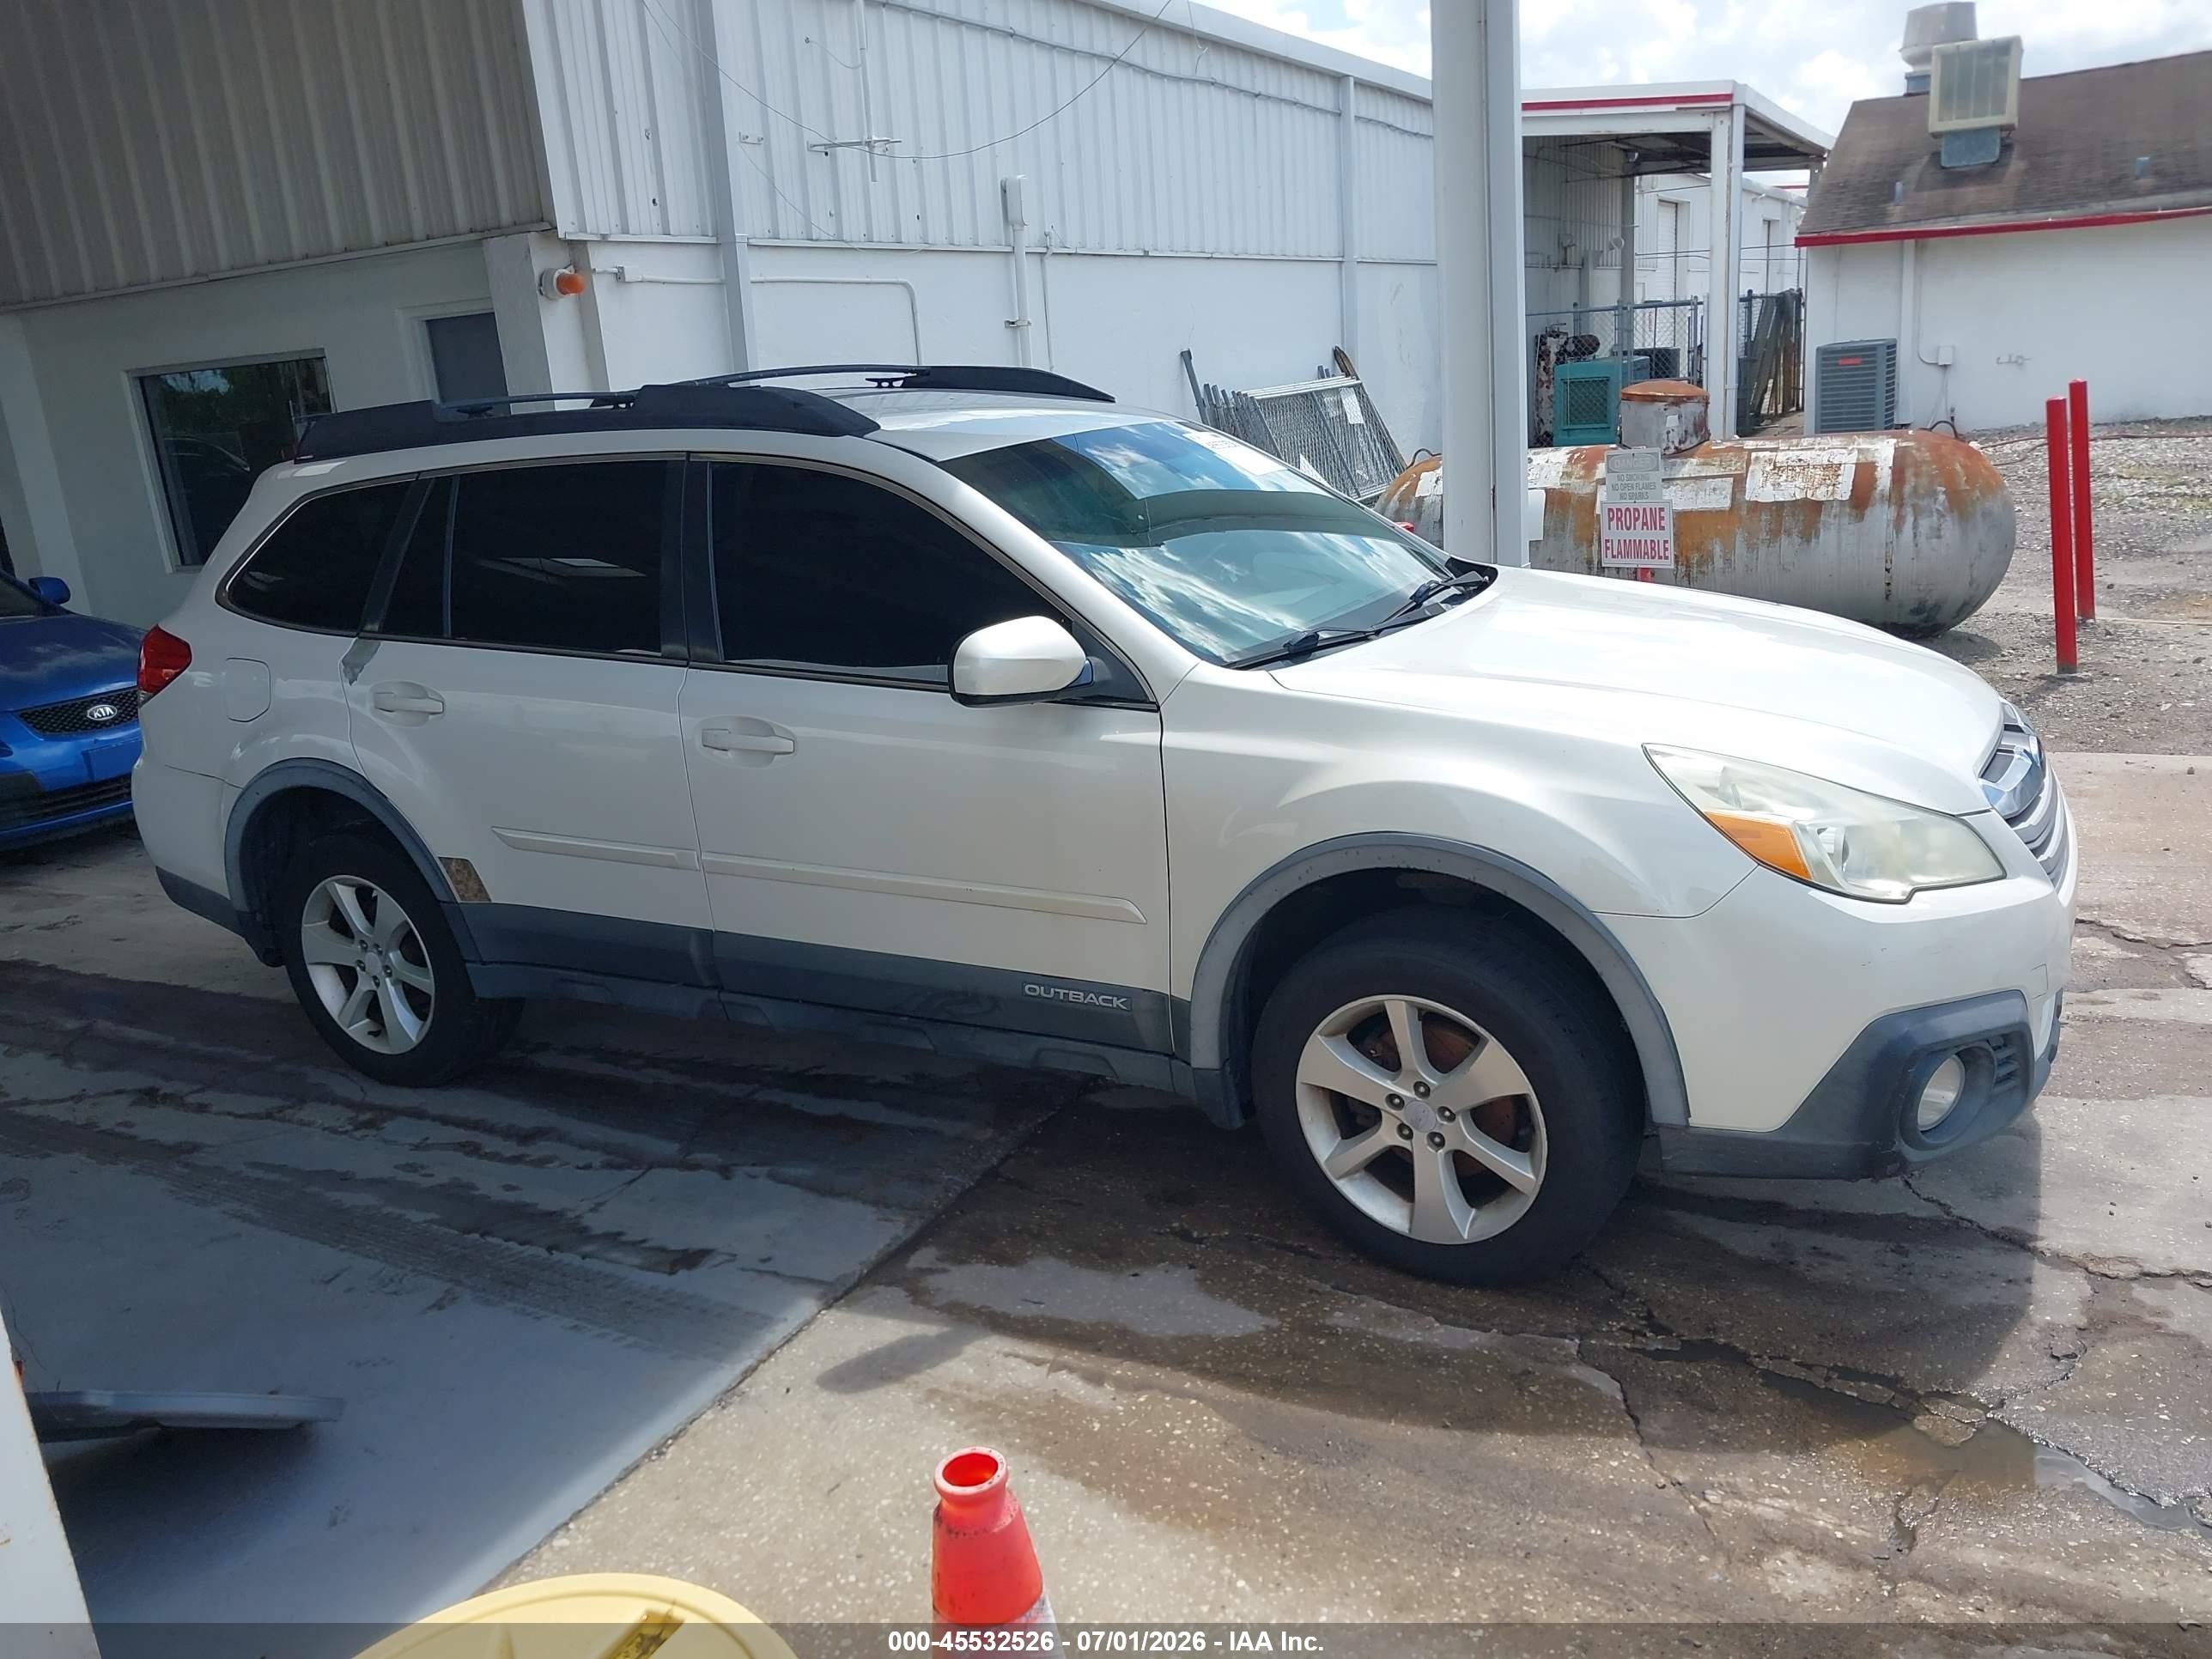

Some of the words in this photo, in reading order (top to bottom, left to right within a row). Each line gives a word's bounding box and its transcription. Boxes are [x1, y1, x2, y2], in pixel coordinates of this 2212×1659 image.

[1614, 457, 1651, 468] DANGER
[1626, 473, 1650, 482] SMOKING
[1620, 483, 1635, 491] OPEN
[1635, 482, 1656, 490] FLAMES
[1628, 491, 1650, 500] SPARKS
[1607, 507, 1666, 531] PROPANE
[1604, 538, 1669, 561] FLAMMABLE
[94, 707, 114, 719] KIA
[1024, 983, 1127, 1010] OUTBACK
